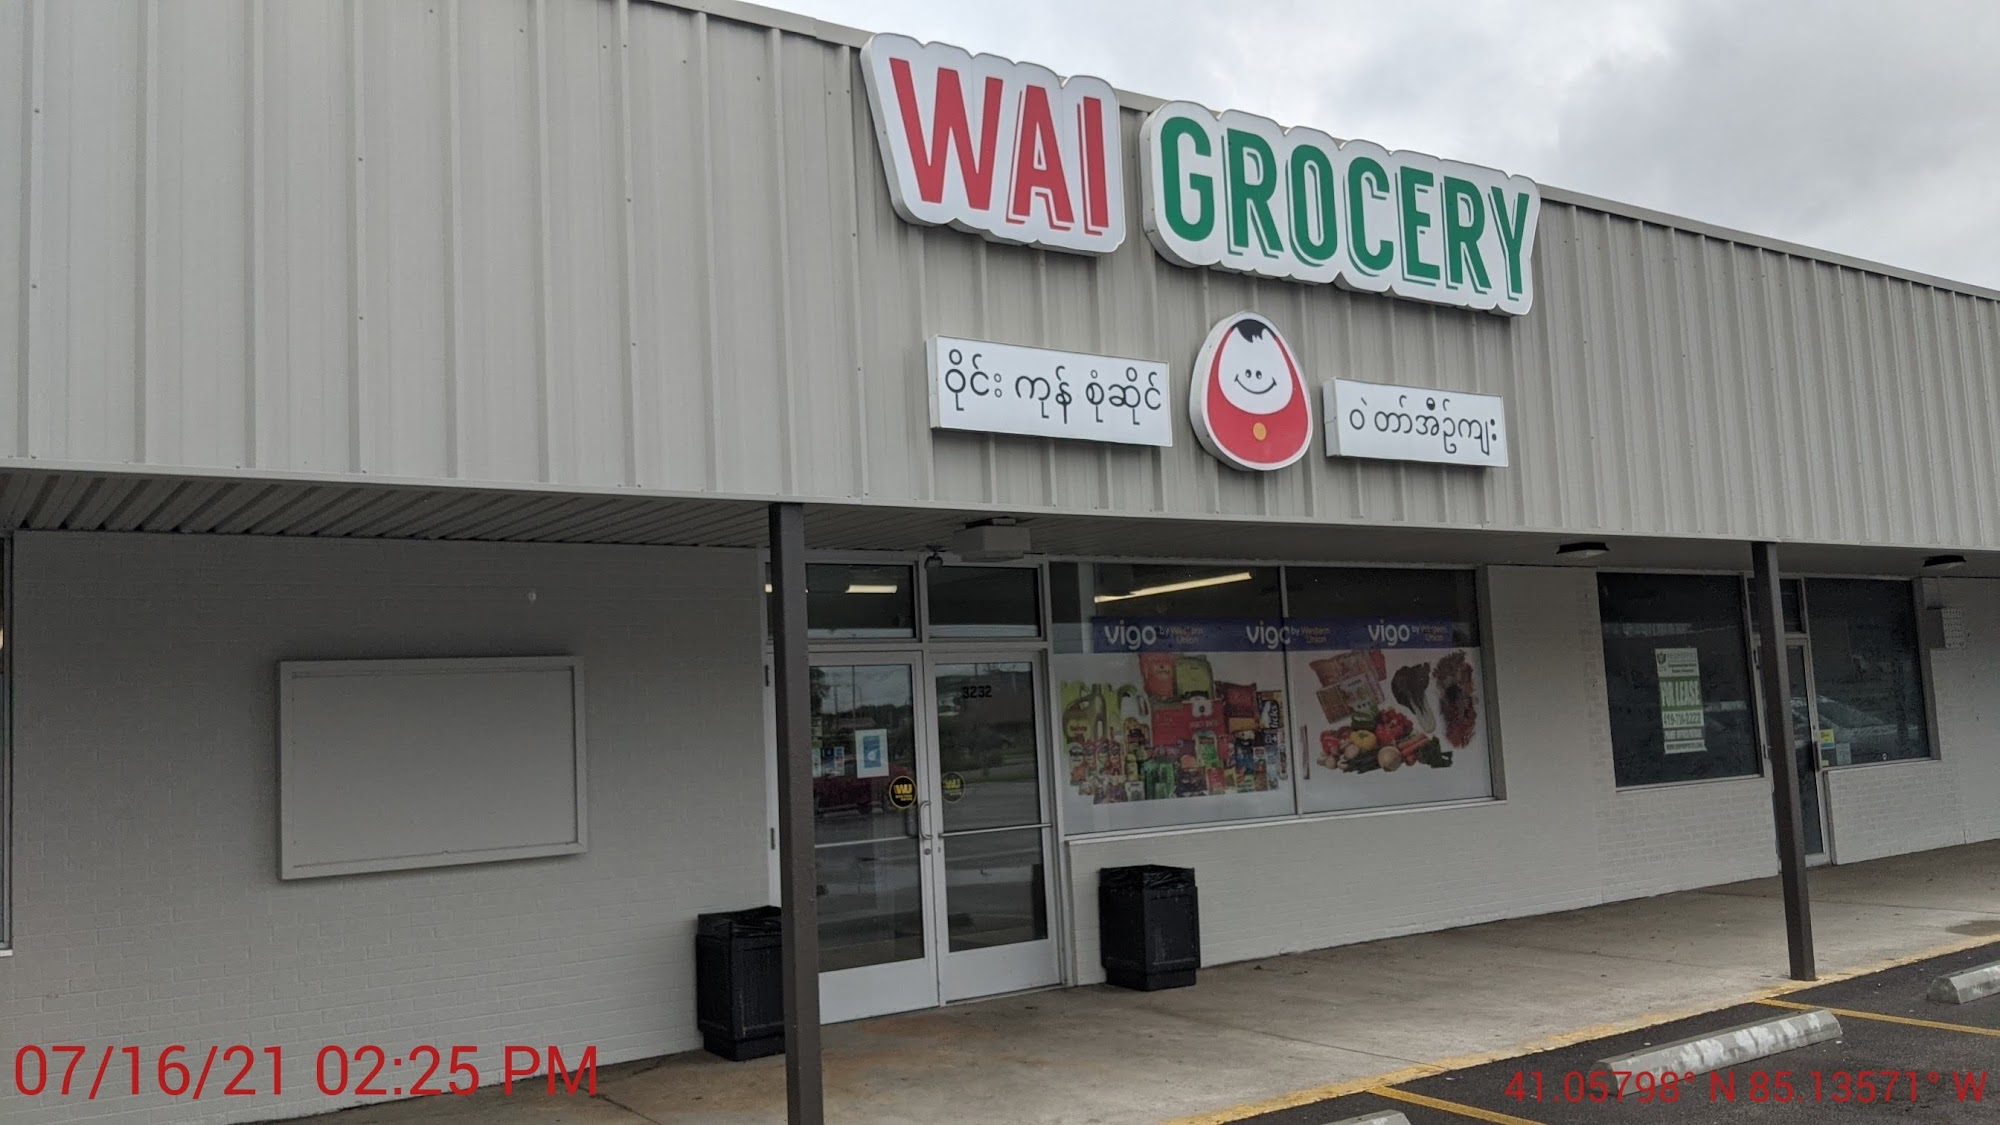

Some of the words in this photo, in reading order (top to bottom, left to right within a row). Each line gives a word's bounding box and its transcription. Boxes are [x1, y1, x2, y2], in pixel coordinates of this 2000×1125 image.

[889, 57, 1109, 235] WAI
[1160, 116, 1530, 301] GROCERY
[1104, 619, 1157, 650] vigo
[1367, 619, 1410, 646] vigo
[961, 685, 993, 698] 3232
